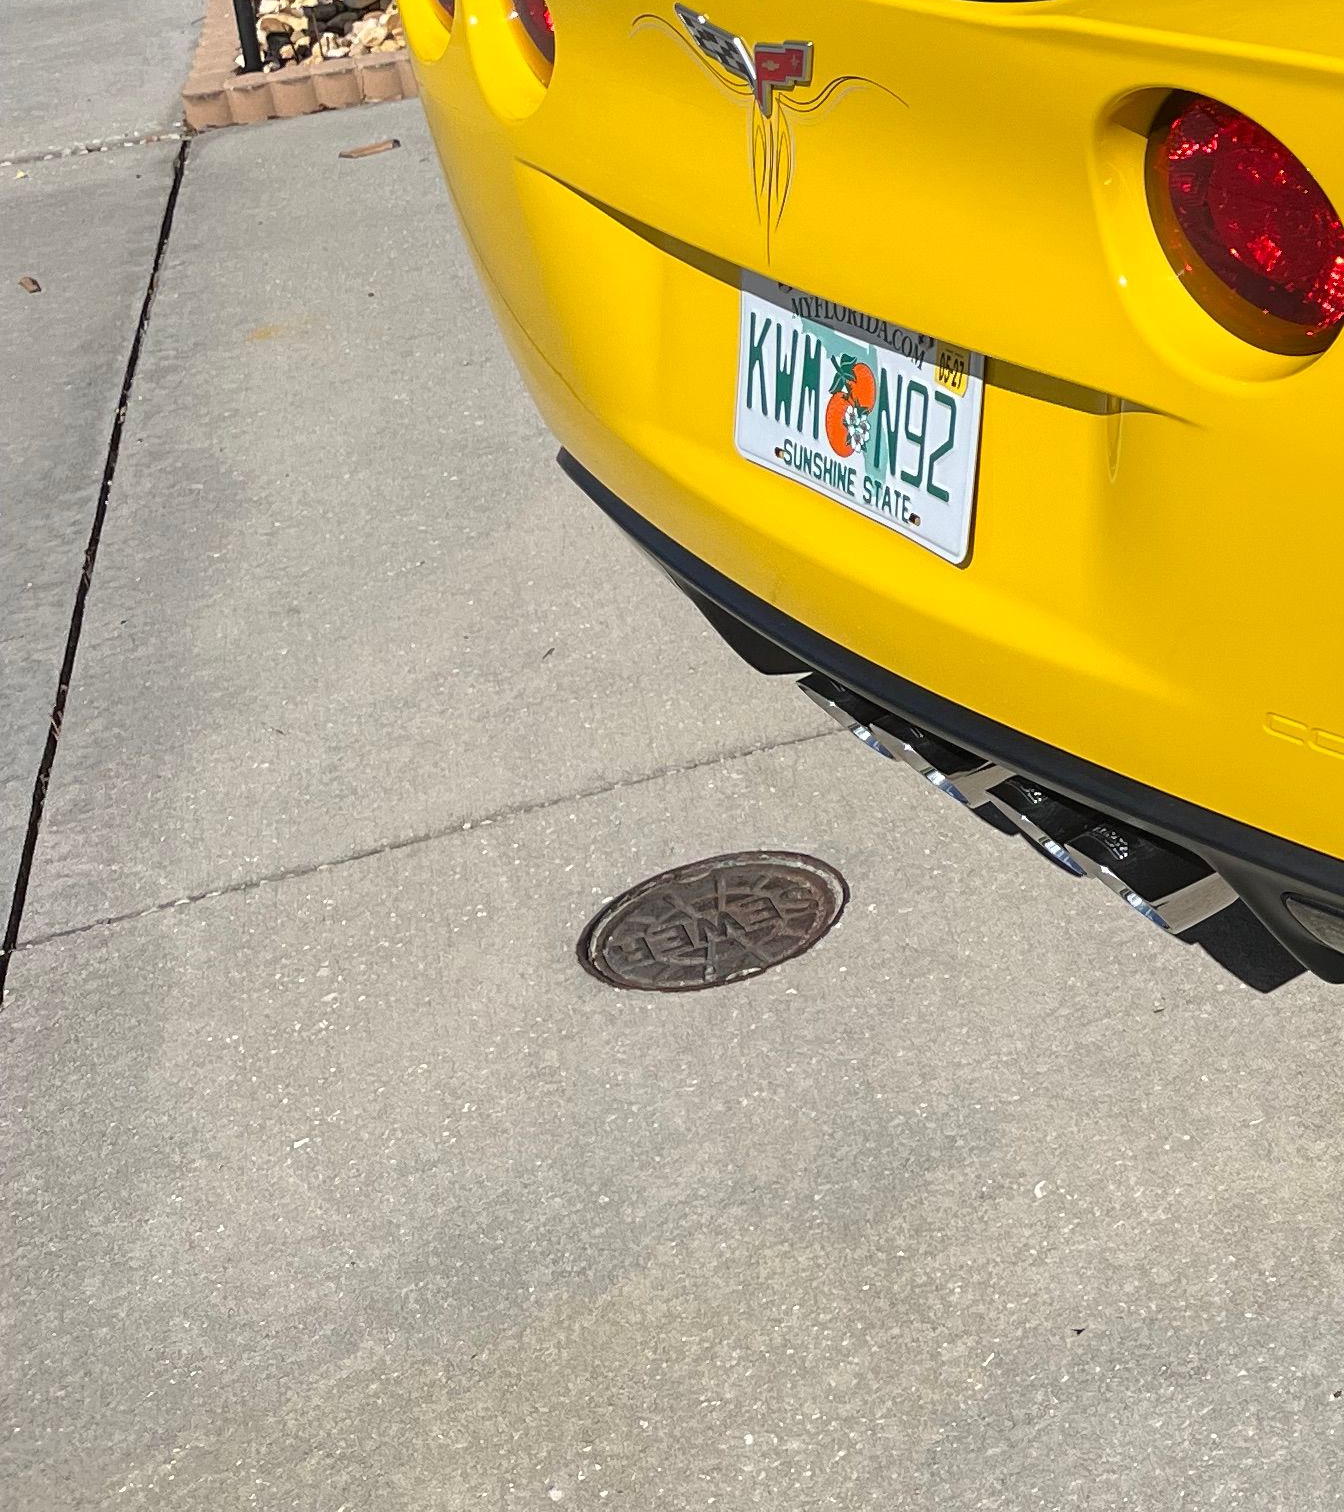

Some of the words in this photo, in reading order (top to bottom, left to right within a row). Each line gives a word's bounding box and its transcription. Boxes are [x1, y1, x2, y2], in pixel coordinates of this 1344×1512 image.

[791, 297, 926, 370] MYFLORIDA.COM
[746, 311, 822, 441] KWM
[873, 366, 957, 504] N92
[783, 438, 857, 497] SUNSHINE
[862, 475, 911, 525] STATE
[607, 889, 820, 962] SEWER
